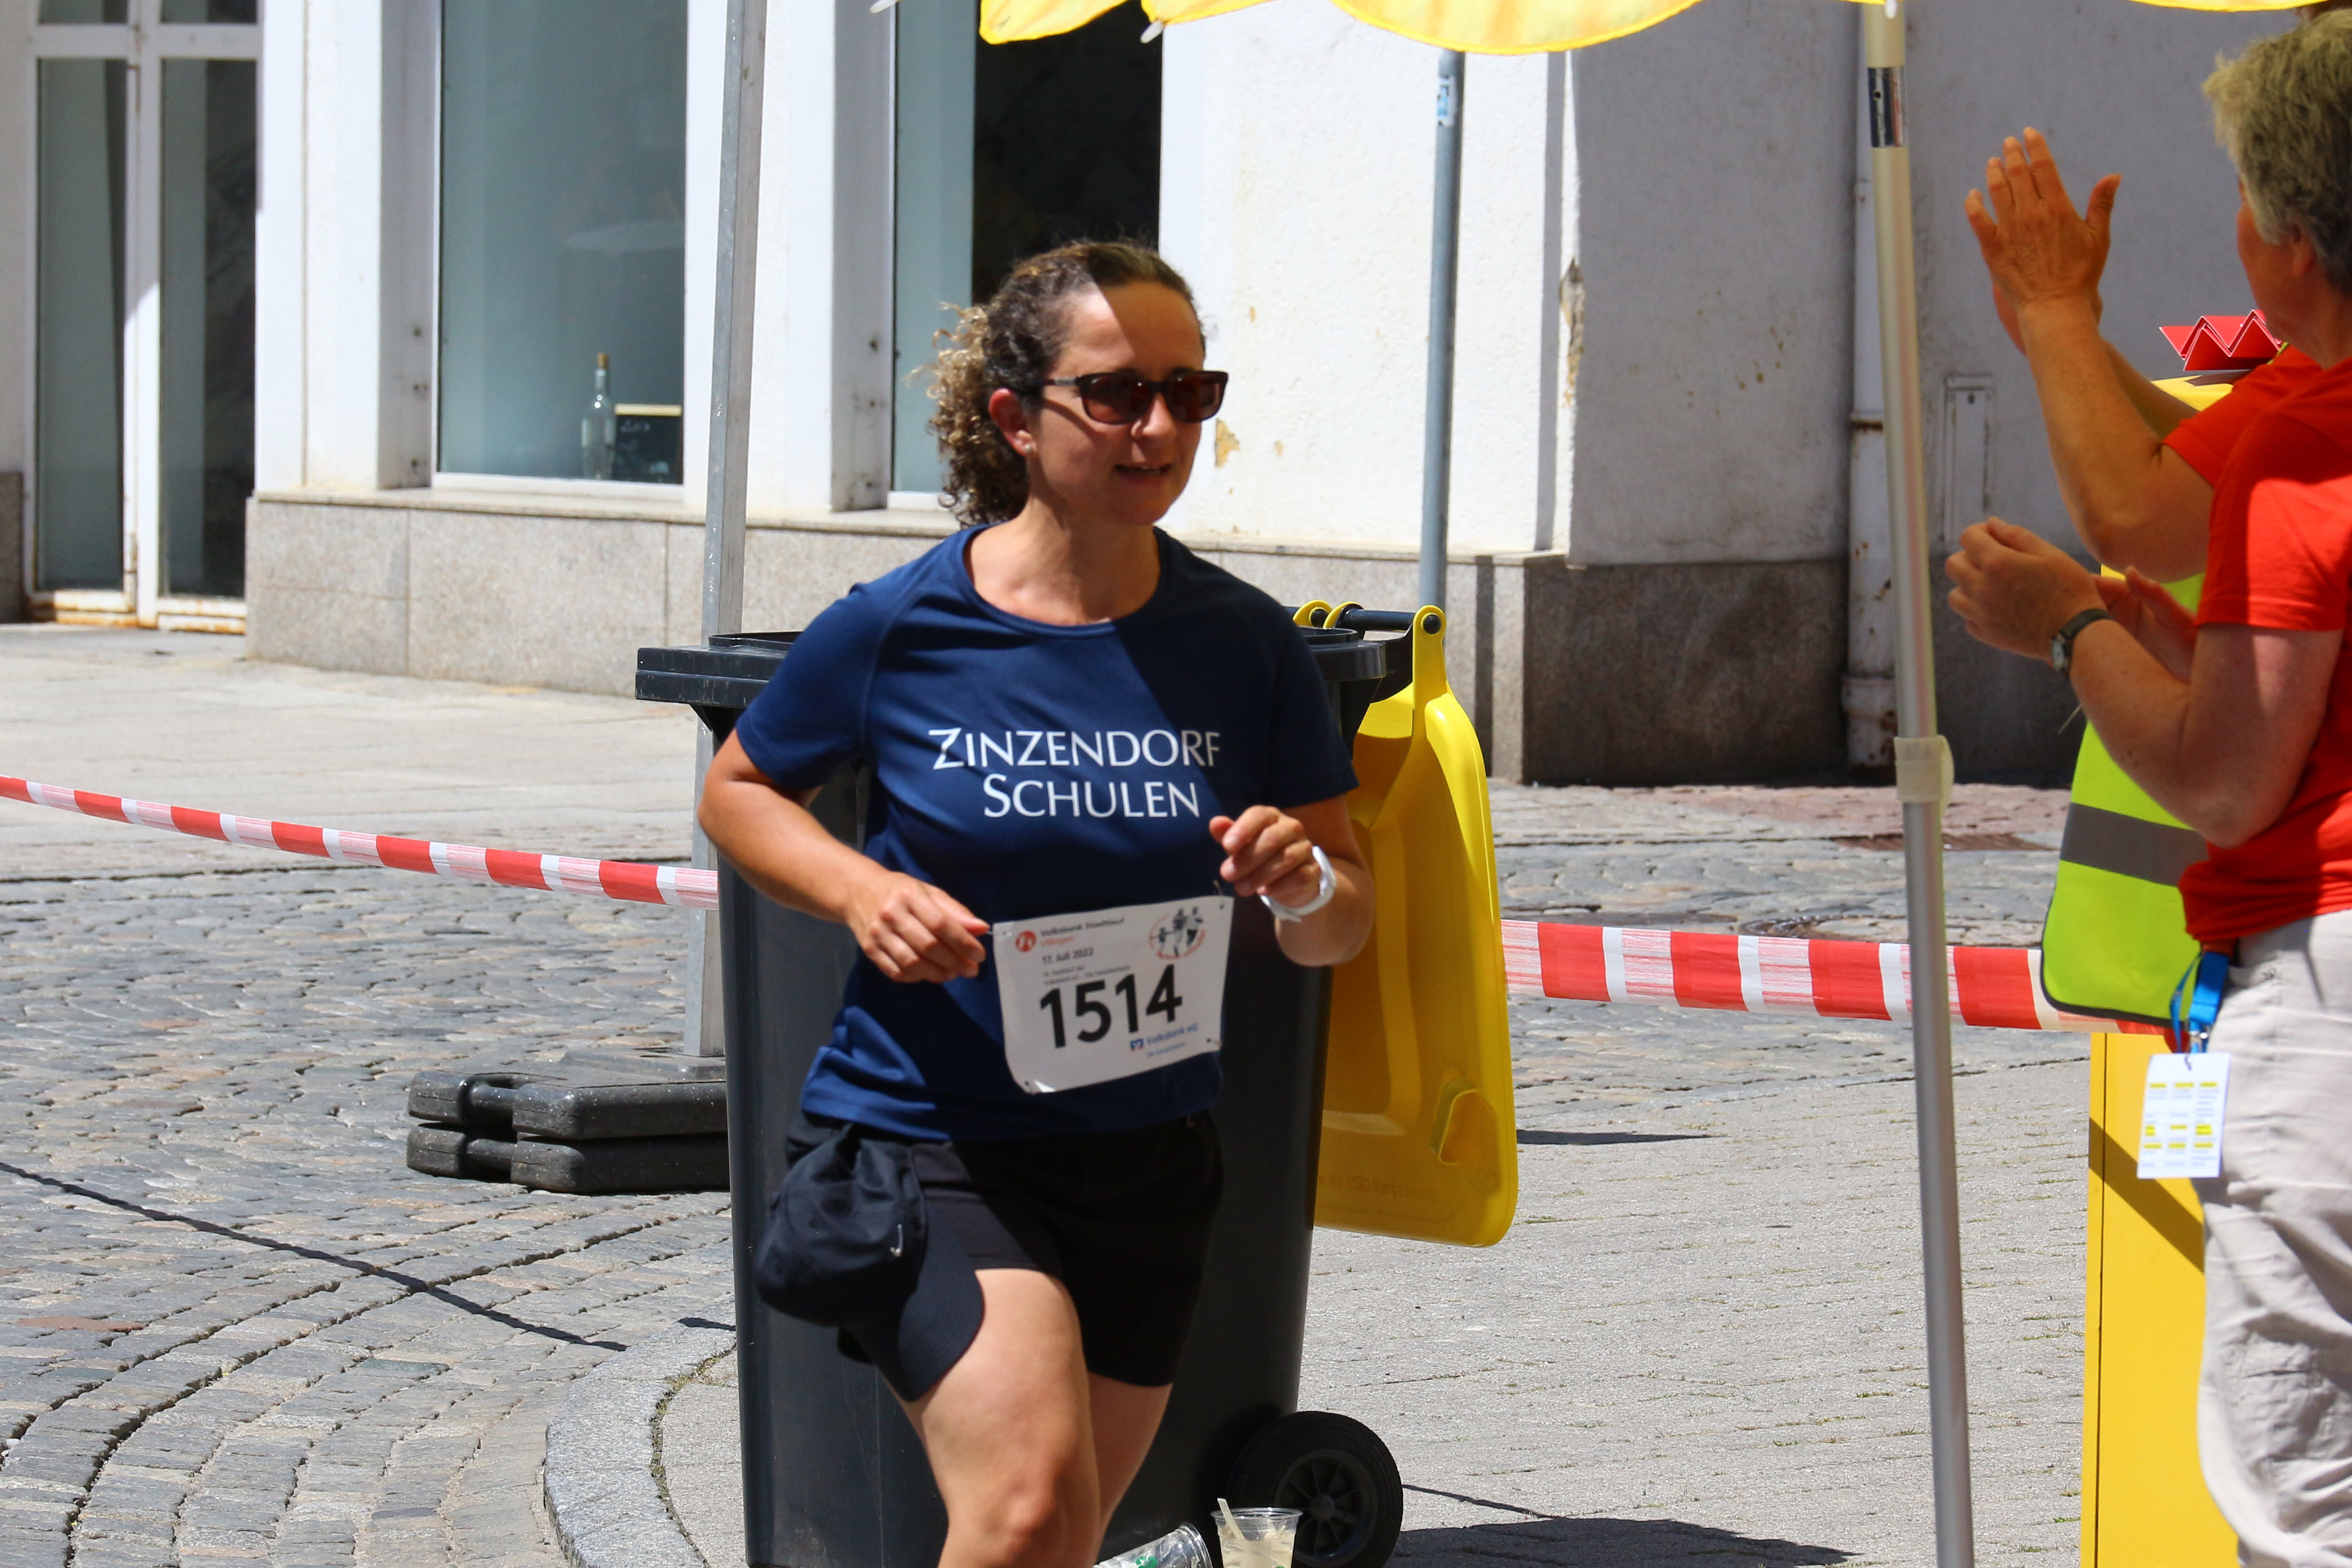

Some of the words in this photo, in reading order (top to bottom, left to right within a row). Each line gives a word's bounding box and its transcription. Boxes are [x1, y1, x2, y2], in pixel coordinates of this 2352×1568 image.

[928, 728, 1220, 770] ZINZENDORF
[982, 773, 1200, 817] SCHULEN
[1056, 951, 1070, 962] Juli
[1073, 947, 1094, 959] 2022
[1040, 965, 1183, 1048] 1514
